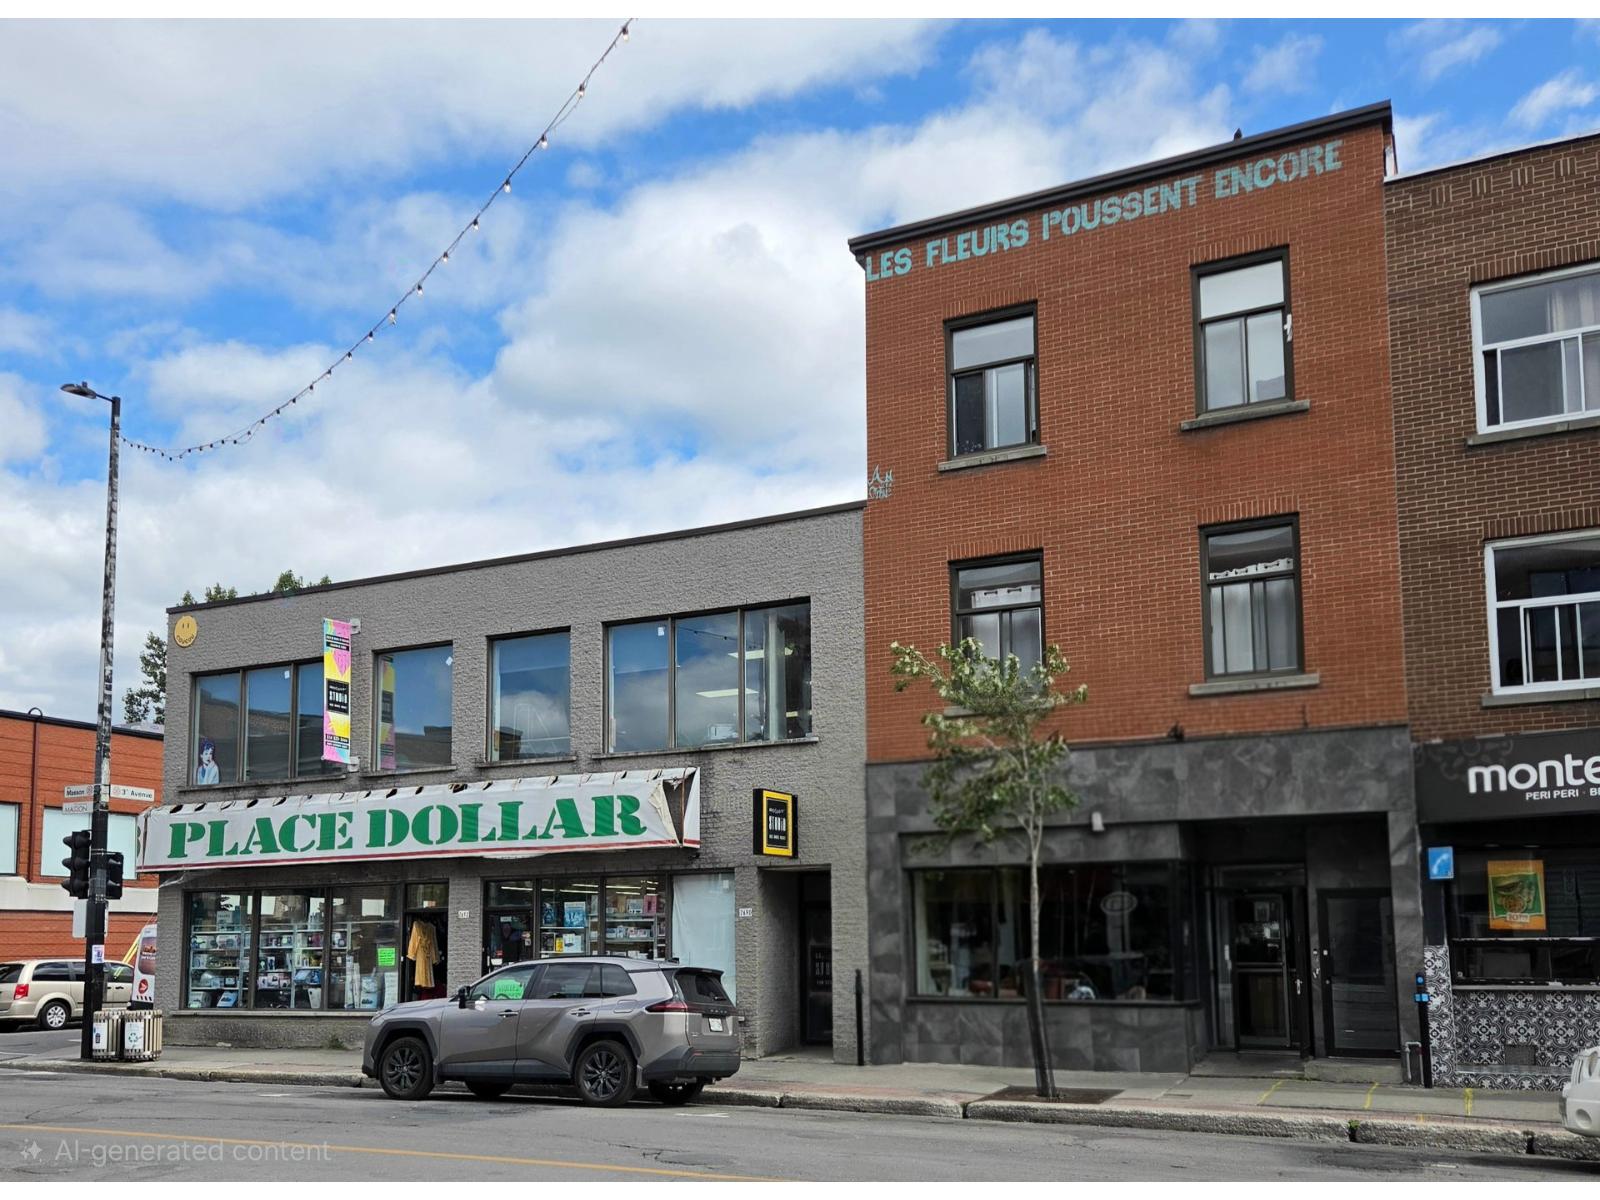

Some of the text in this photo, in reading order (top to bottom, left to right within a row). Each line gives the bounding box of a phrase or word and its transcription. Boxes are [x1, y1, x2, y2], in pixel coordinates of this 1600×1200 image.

[866, 140, 1343, 282] LES FLEURS POUSSENT ENCORE
[66, 789, 85, 797] Masson
[130, 790, 153, 799] Avenue
[1525, 790, 1551, 801] PERI
[1553, 788, 1579, 799] PERI
[167, 811, 353, 859] PLACE
[365, 794, 647, 848] DOLLAR
